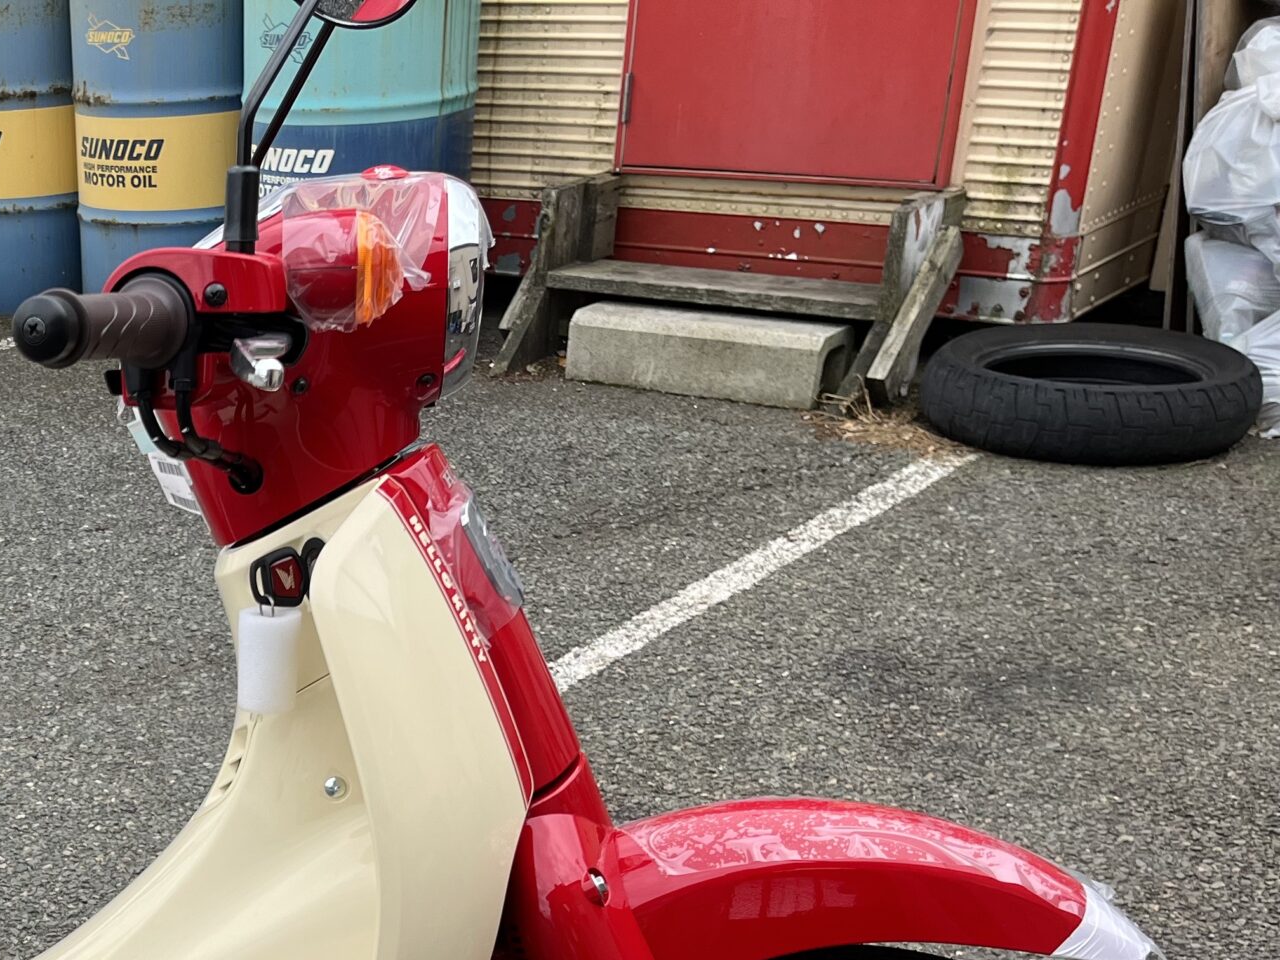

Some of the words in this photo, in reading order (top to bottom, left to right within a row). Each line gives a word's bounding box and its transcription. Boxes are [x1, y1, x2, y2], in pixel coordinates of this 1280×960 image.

[88, 31, 130, 44] SUNOCO
[262, 33, 308, 47] SUNO
[81, 136, 164, 161] SUNOCO
[252, 144, 335, 174] NOCO
[96, 164, 157, 174] PERFORMANCE
[84, 171, 125, 188] MOTOR
[131, 175, 157, 188] OIL
[409, 515, 453, 590] HELLO
[451, 591, 487, 663] KITTY
